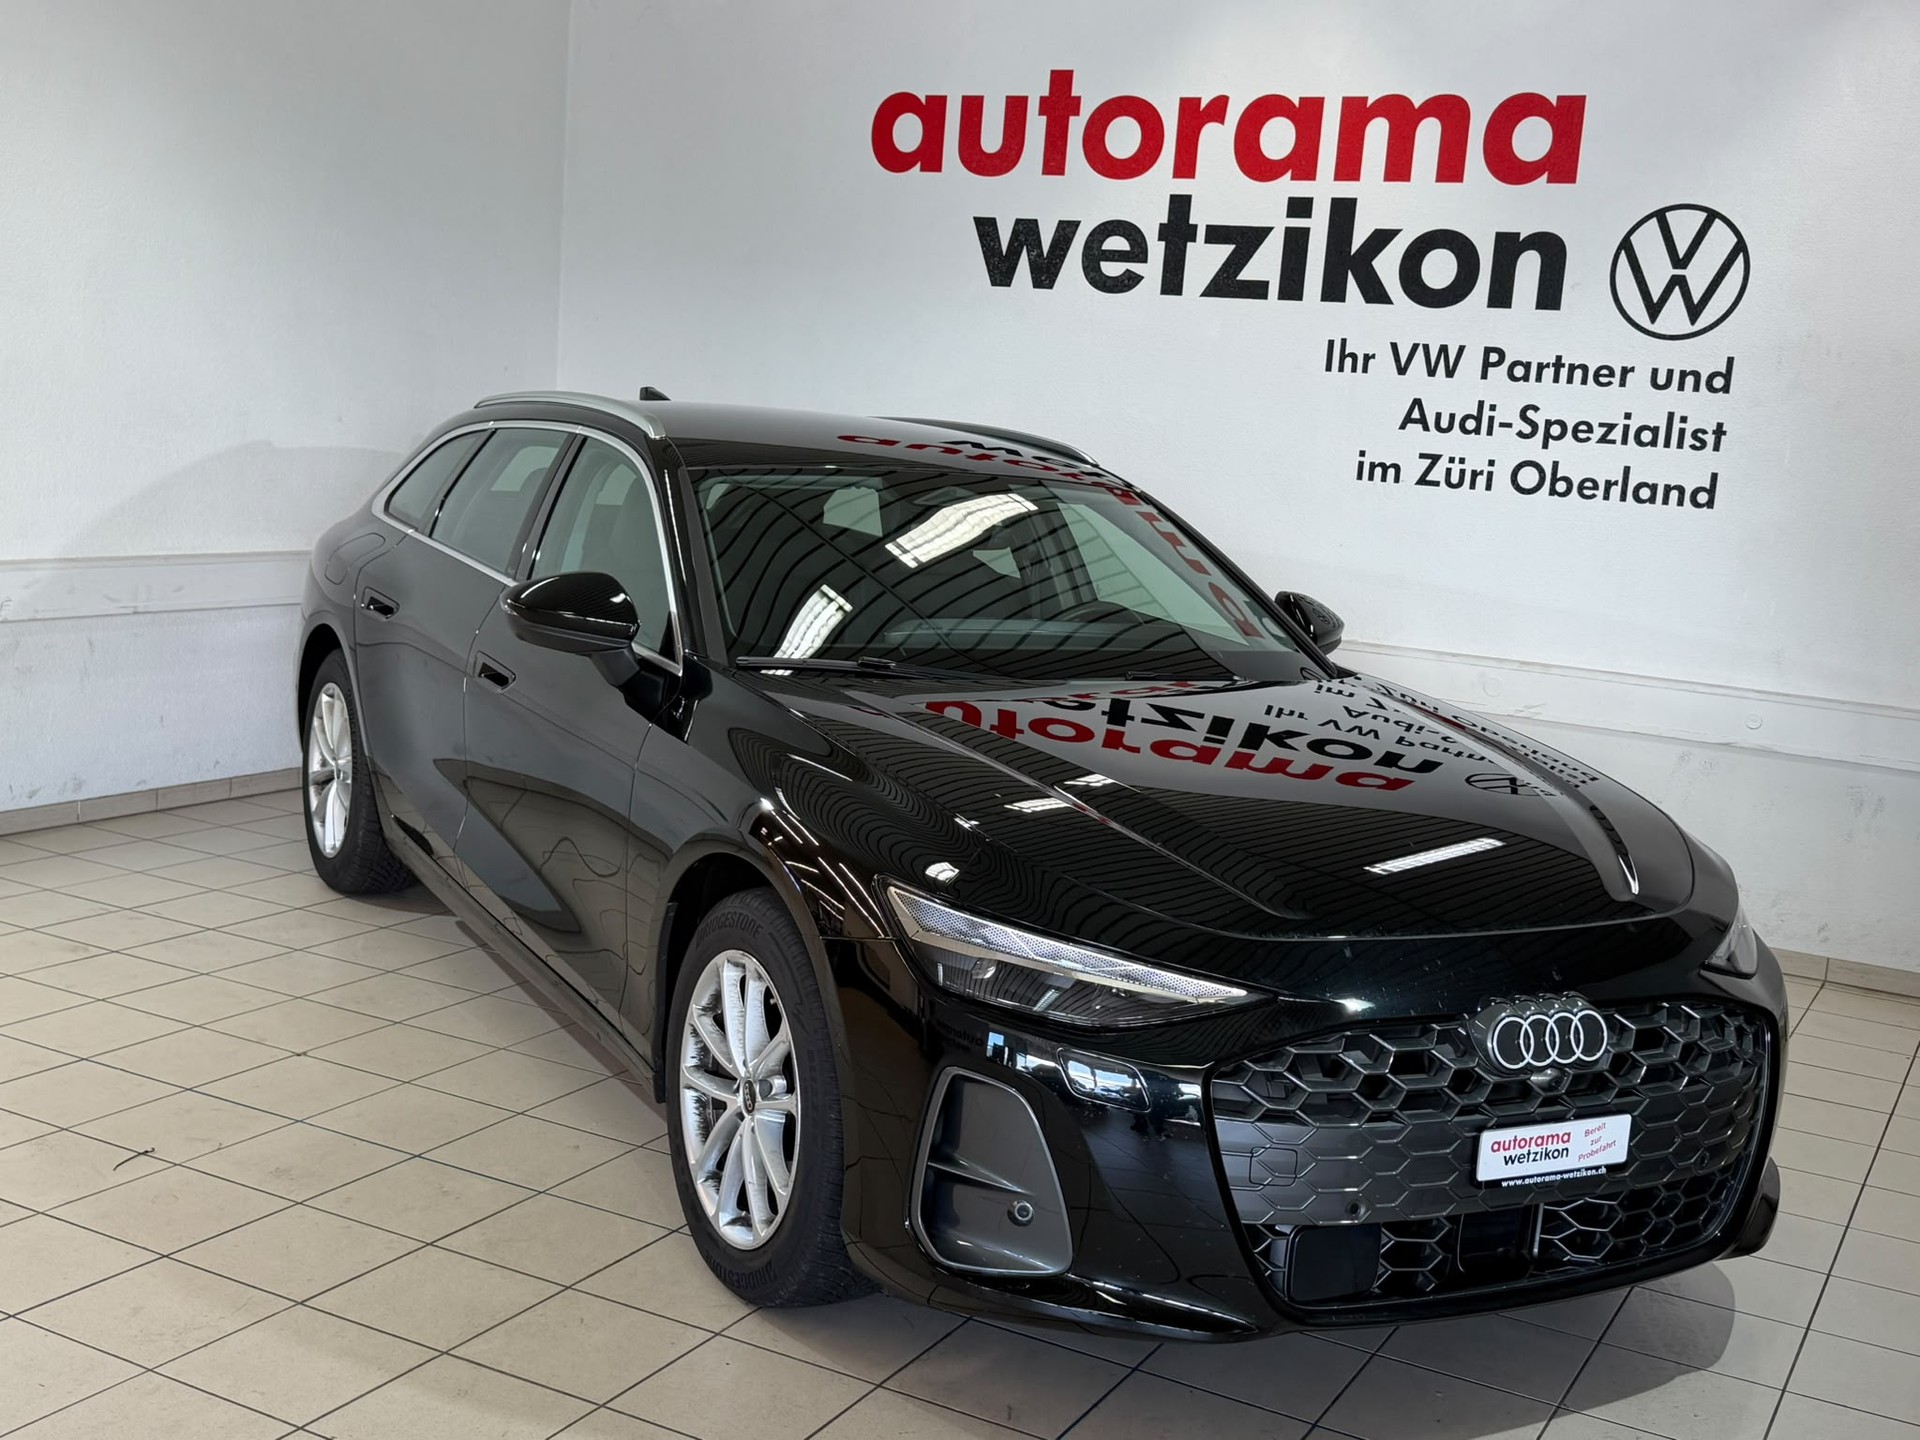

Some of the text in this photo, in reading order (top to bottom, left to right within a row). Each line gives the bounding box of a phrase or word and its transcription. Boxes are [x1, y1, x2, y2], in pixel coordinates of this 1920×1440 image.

[872, 70, 1587, 186] autorama
[973, 194, 1568, 310] wetzikon
[1326, 338, 1735, 395] Ihr VW Partner und
[1399, 398, 1728, 453] Audi-Spezialist
[1357, 450, 1719, 510] im Züri Oberland
[1584, 1122, 1607, 1138] Bereit
[1590, 1135, 1603, 1146] zur
[1491, 1131, 1572, 1153] autorama
[1577, 1140, 1617, 1162] Probefahrt
[1503, 1147, 1570, 1166] wetzikon
[1501, 1166, 1607, 1187] www.autorama-wetzikon.ch
